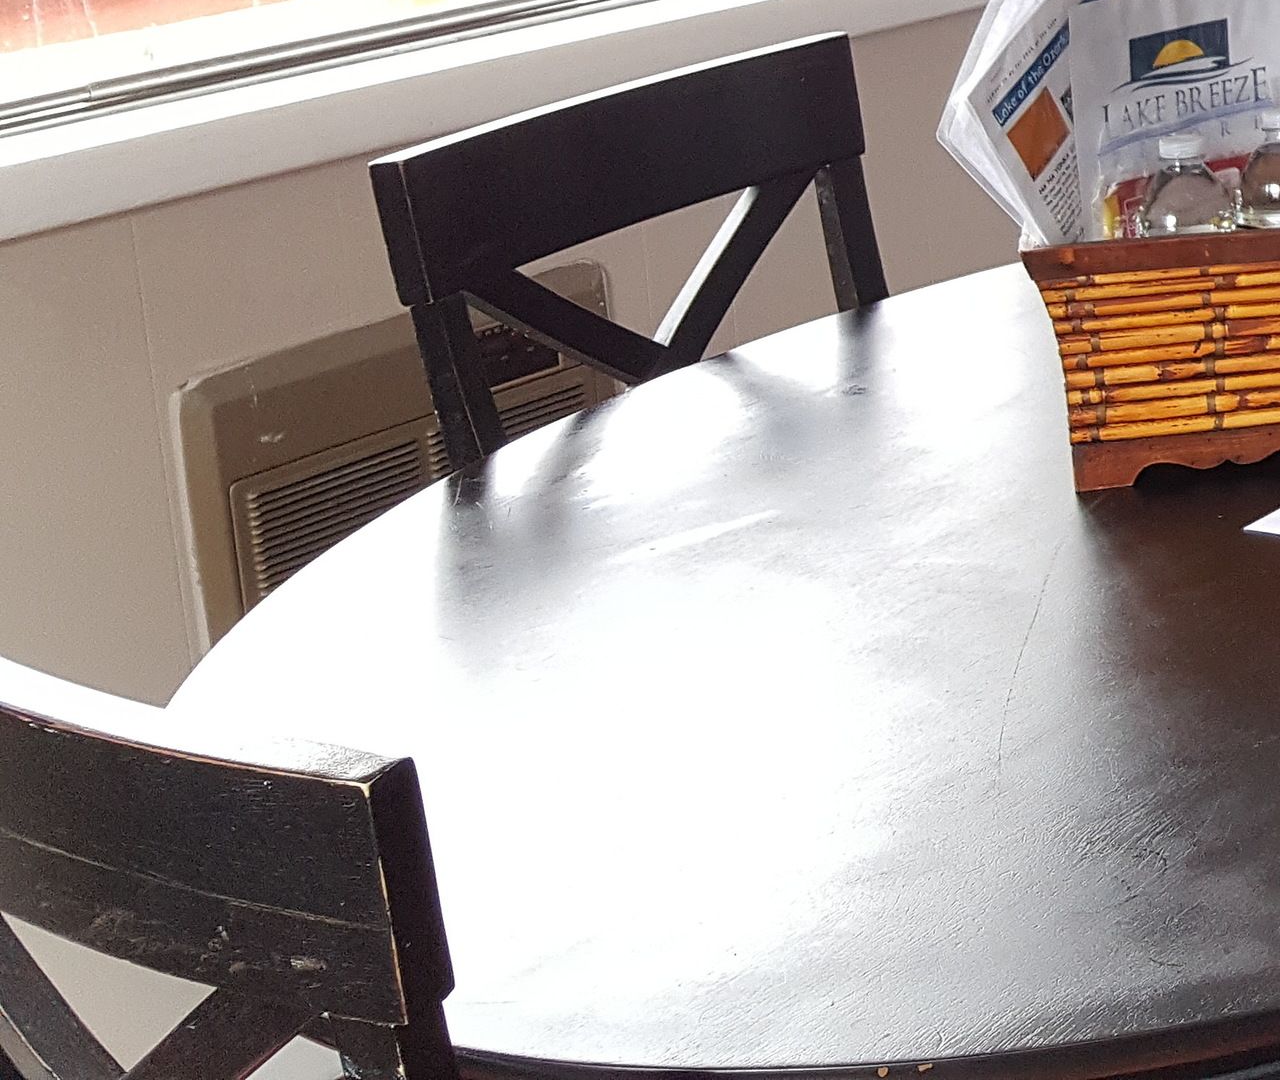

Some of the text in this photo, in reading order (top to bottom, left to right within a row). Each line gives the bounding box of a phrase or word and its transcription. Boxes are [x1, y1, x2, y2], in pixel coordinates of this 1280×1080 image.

[994, 96, 1018, 125] Lake
[1018, 82, 1029, 98] of
[1028, 66, 1045, 86] the
[1101, 94, 1166, 133] LAKE
